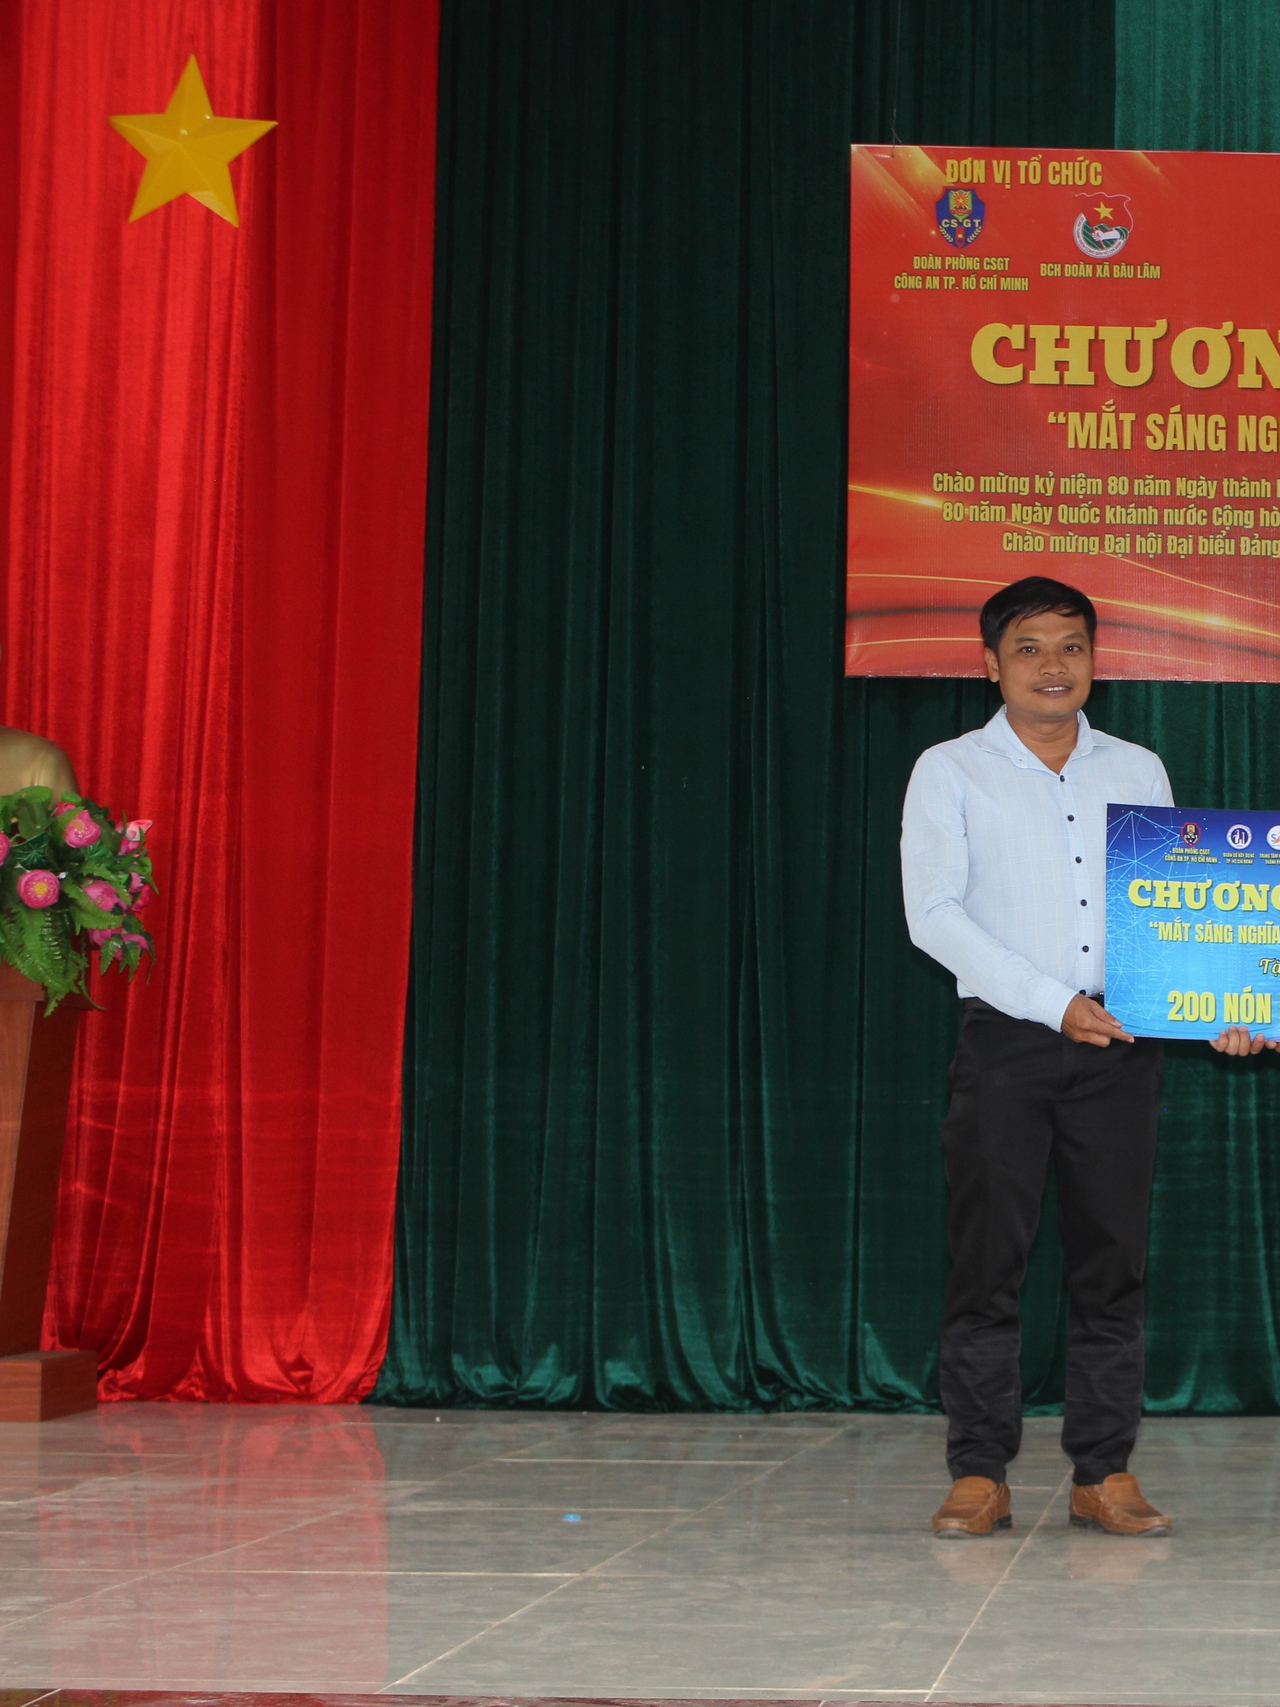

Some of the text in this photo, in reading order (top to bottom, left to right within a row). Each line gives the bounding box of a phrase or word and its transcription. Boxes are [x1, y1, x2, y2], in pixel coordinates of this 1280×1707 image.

[946, 154, 1102, 189] ĐƠN VỊ TỔ CHỨC
[913, 254, 1010, 271] ĐOÀN PHÒNG CSGT
[1040, 261, 1161, 279] BCH ĐOÀN XÃ BÀU LÂM
[894, 273, 1028, 290] CÔNG AN TP. HỒ CHÍ MINH
[1145, 404, 1227, 452] SÁNG
[932, 471, 975, 493] Chào
[980, 472, 1030, 496] mừng
[1035, 470, 1055, 496] kỷ
[1060, 472, 1102, 499] niệm
[1107, 475, 1129, 495] 80
[1133, 474, 1171, 497] năm
[1176, 475, 1217, 499] Ngày
[1222, 476, 1271, 498] thành
[942, 502, 964, 522] 80
[969, 500, 1006, 522] năm
[1011, 501, 1053, 525] Ngày
[1057, 500, 1100, 525] Quốc
[1105, 503, 1158, 525] khánh
[1163, 503, 1207, 526] nước
[1212, 505, 1254, 530] Cộng
[1002, 530, 1044, 552] Chào
[1050, 531, 1099, 556] mừng
[1104, 533, 1130, 558] Đại
[1135, 532, 1162, 558] hội
[1167, 535, 1193, 559] Đại
[1198, 530, 1235, 556] biểu
[1194, 919, 1233, 943] SÁNG
[1237, 920, 1280, 944] NGHĨA
[1167, 990, 1216, 1023] 200
[1223, 986, 1272, 1023] NÓN
